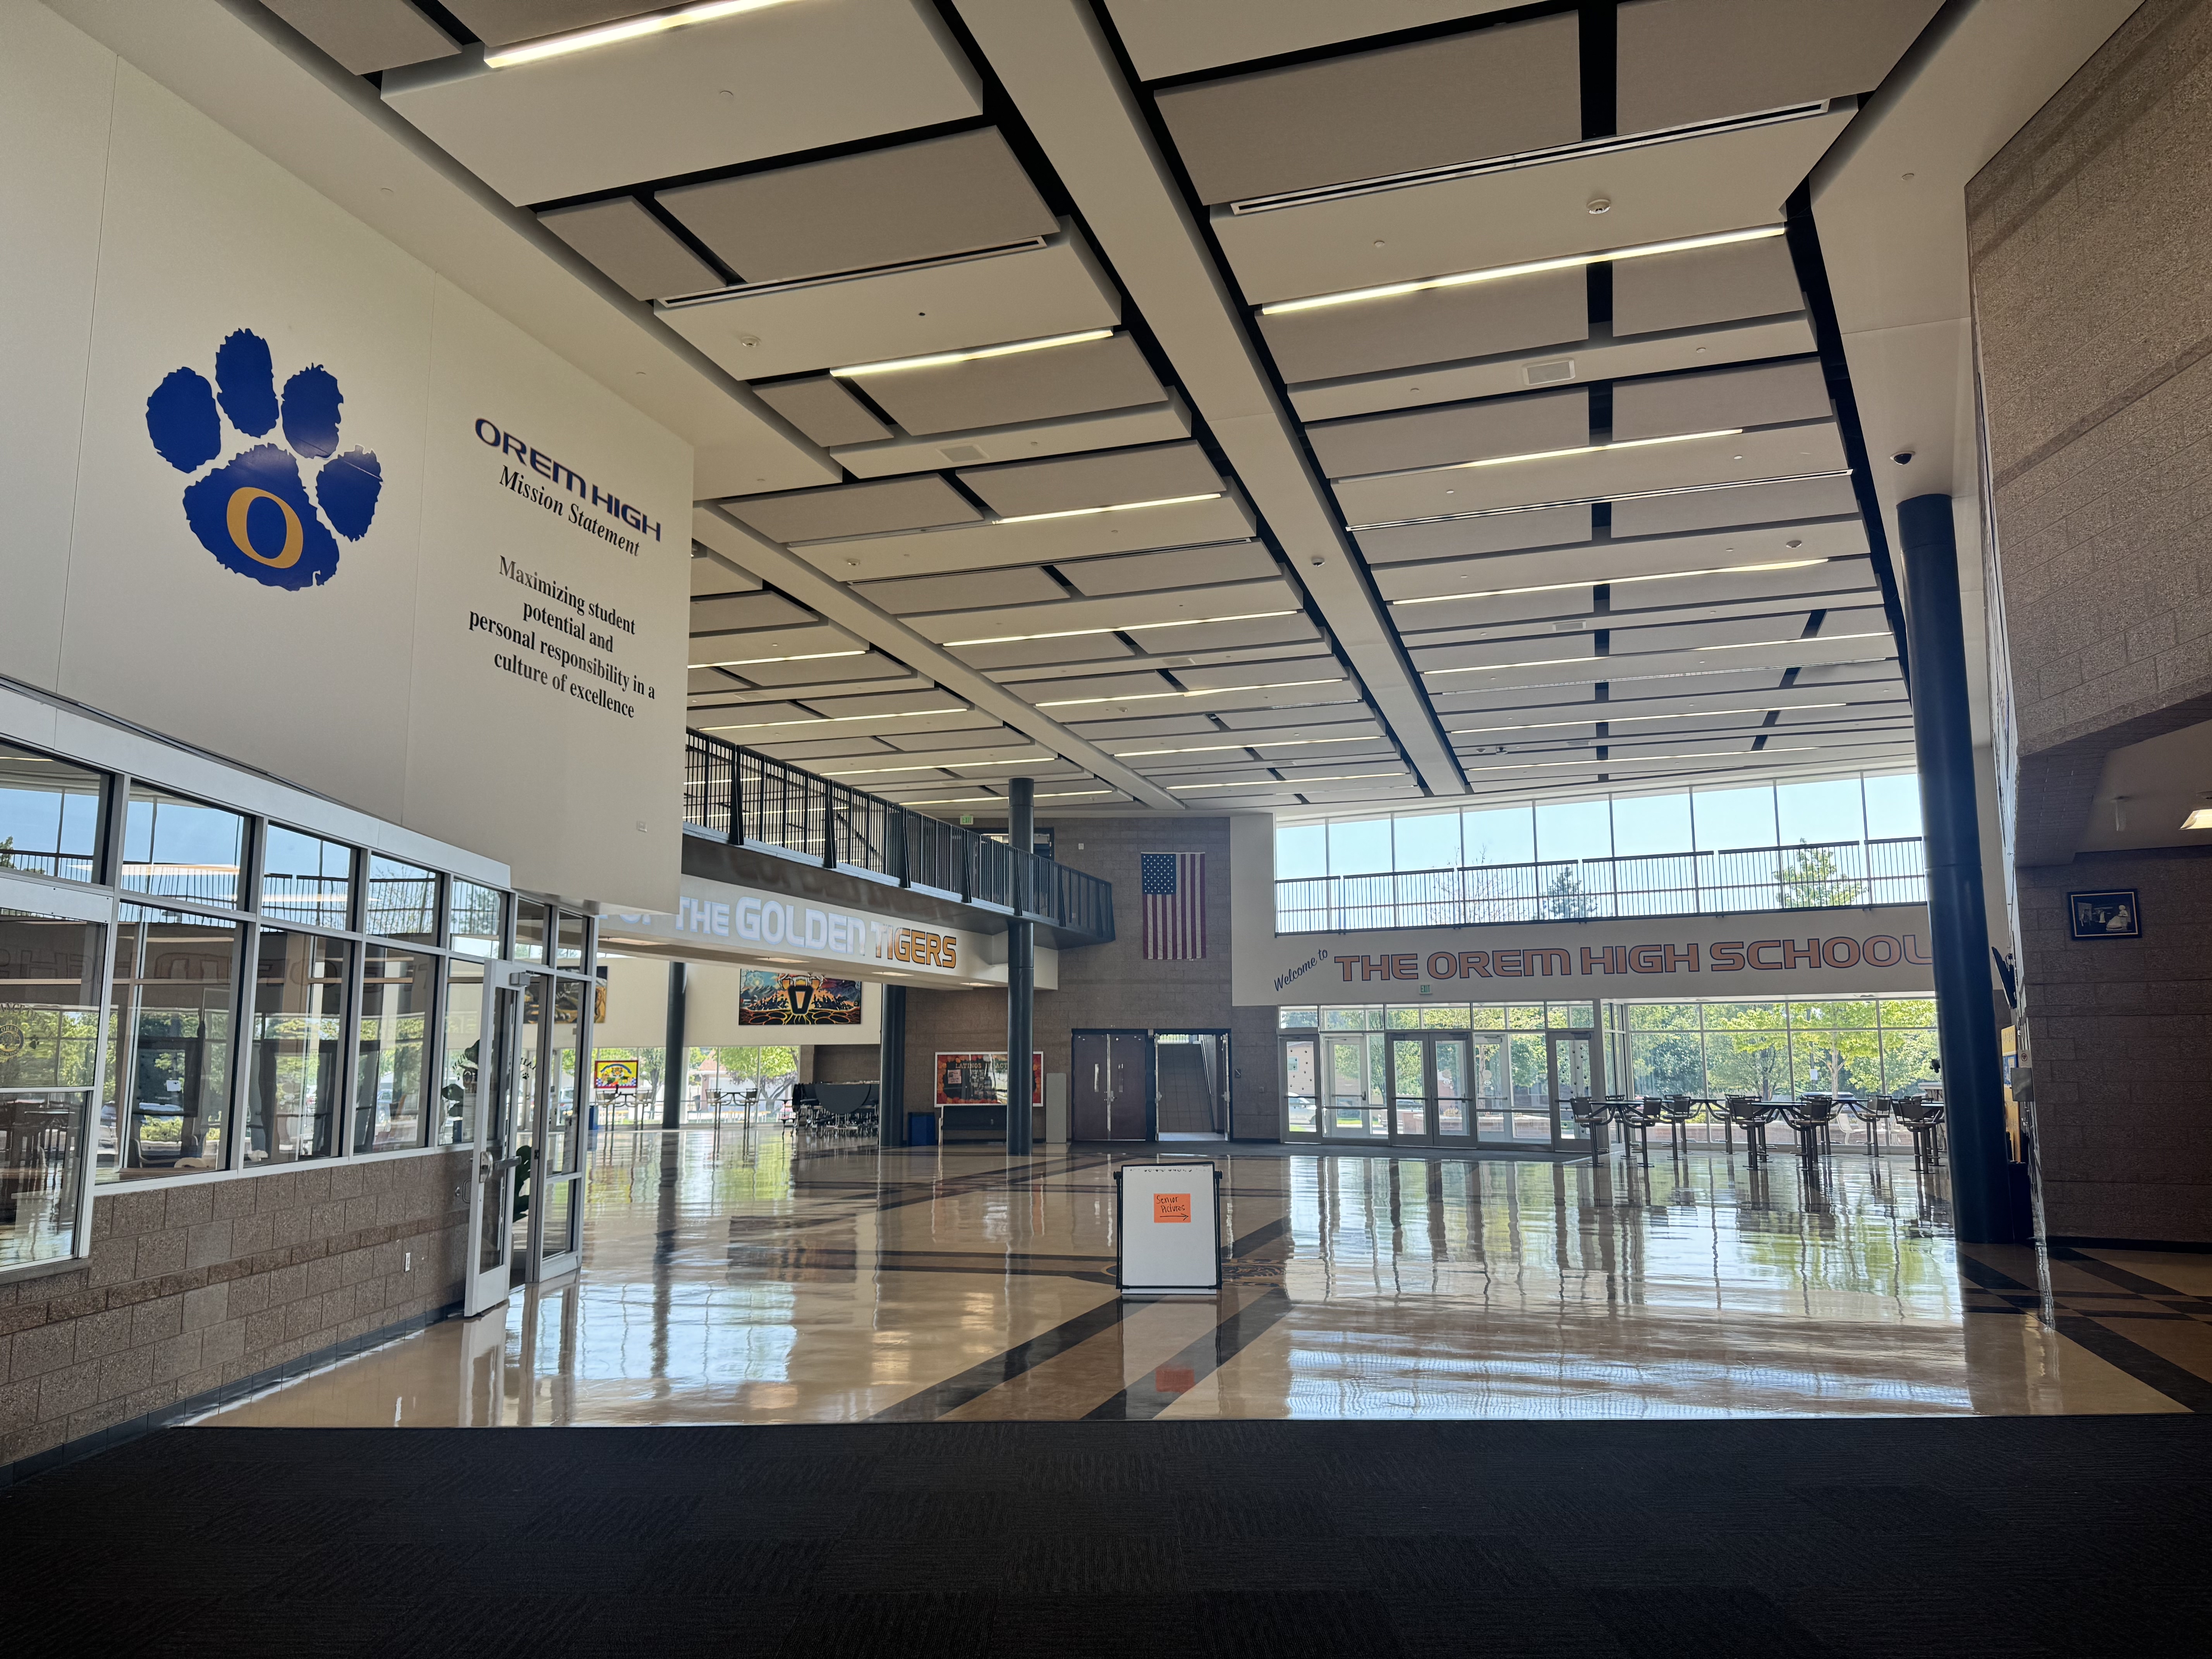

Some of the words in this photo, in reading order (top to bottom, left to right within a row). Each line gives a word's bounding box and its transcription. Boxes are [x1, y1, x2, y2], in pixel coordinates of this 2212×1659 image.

[475, 417, 586, 500] OREM
[592, 483, 661, 542] HIGH
[499, 465, 563, 517] Mission
[568, 503, 640, 556] Statement
[499, 555, 585, 616] Maximizing
[588, 601, 636, 635] student
[523, 602, 585, 641] potential
[589, 632, 613, 653] and
[468, 610, 536, 650] personal
[540, 639, 630, 692] responsibility
[633, 675, 645, 696] in
[648, 686, 655, 699] a
[494, 652, 548, 685] culture
[552, 673, 568, 692] of
[570, 683, 635, 718] excellence
[735, 896, 866, 956] GOLDEN
[870, 920, 957, 969] TIGERS
[1334, 953, 1419, 982] THE
[1427, 947, 1572, 980] OREM
[1580, 943, 1700, 975] HIGH
[1710, 934, 1932, 972] SCHOOL
[1273, 956, 1317, 992] Welcome
[1317, 948, 1328, 961] to
[1156, 1195, 1178, 1204] Senior
